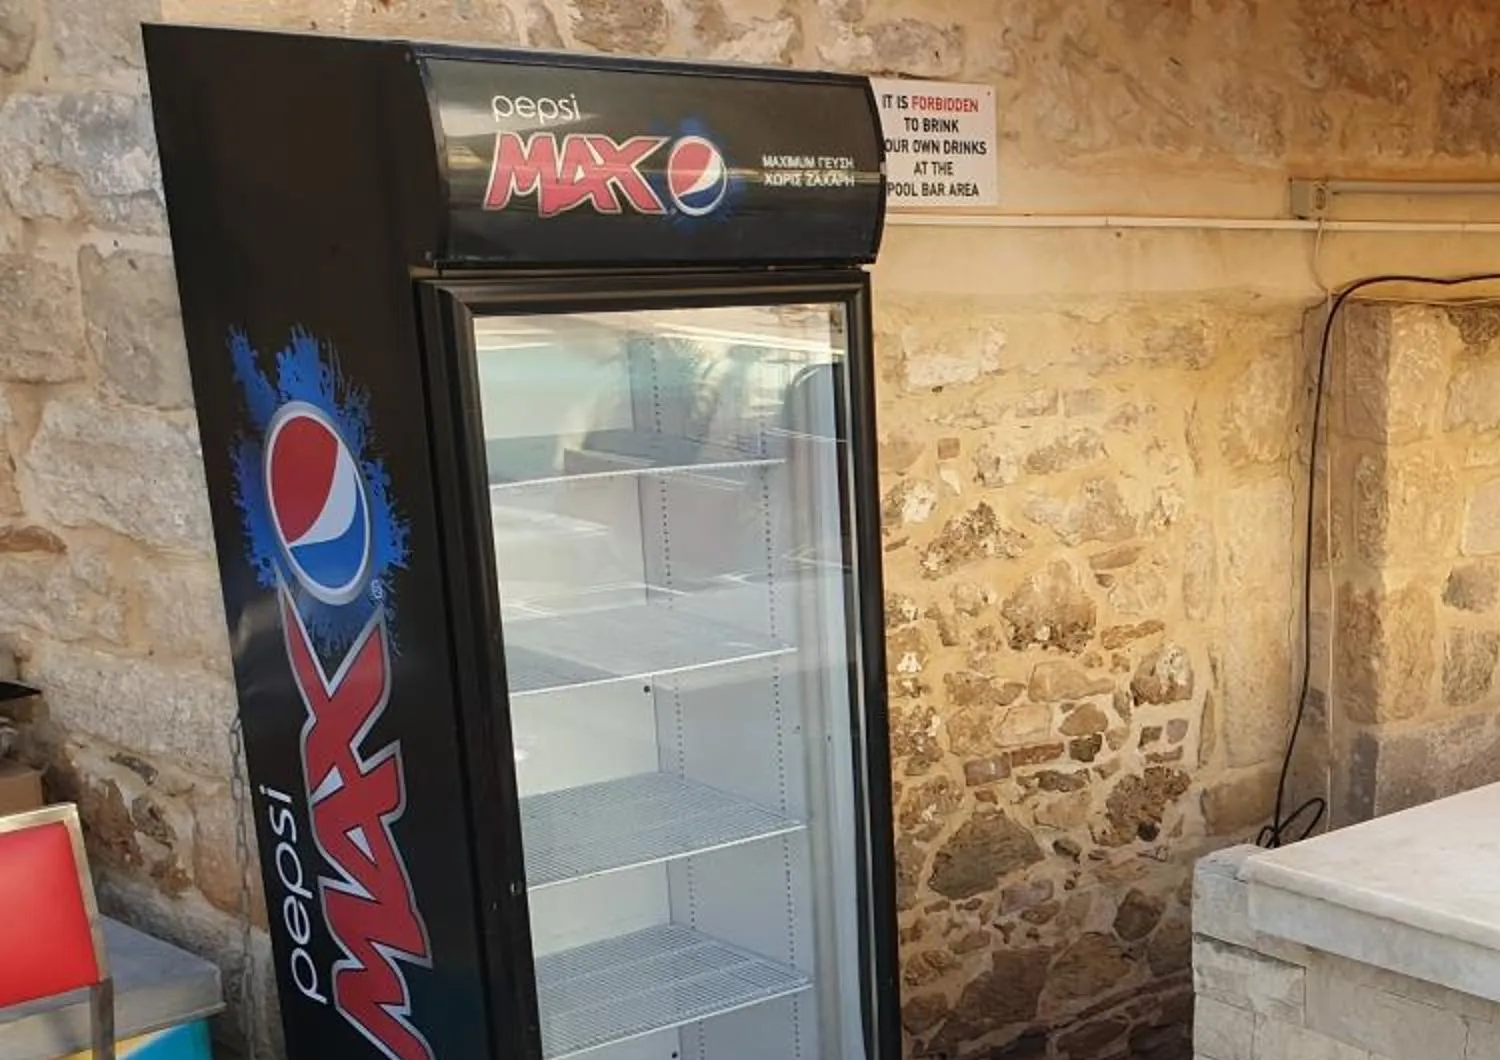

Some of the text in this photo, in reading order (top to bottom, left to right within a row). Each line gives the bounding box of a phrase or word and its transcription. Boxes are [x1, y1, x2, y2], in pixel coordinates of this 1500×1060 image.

[491, 93, 581, 124] pepsi
[882, 94, 979, 113] IT IS FORBIDDEN
[904, 117, 919, 132] TO
[883, 138, 987, 155] OUR OWN DRINKS
[483, 131, 670, 218] MAX
[914, 161, 954, 176] AT THE
[887, 182, 979, 197] POOL BAR AREA
[259, 784, 328, 1005] pepsi
